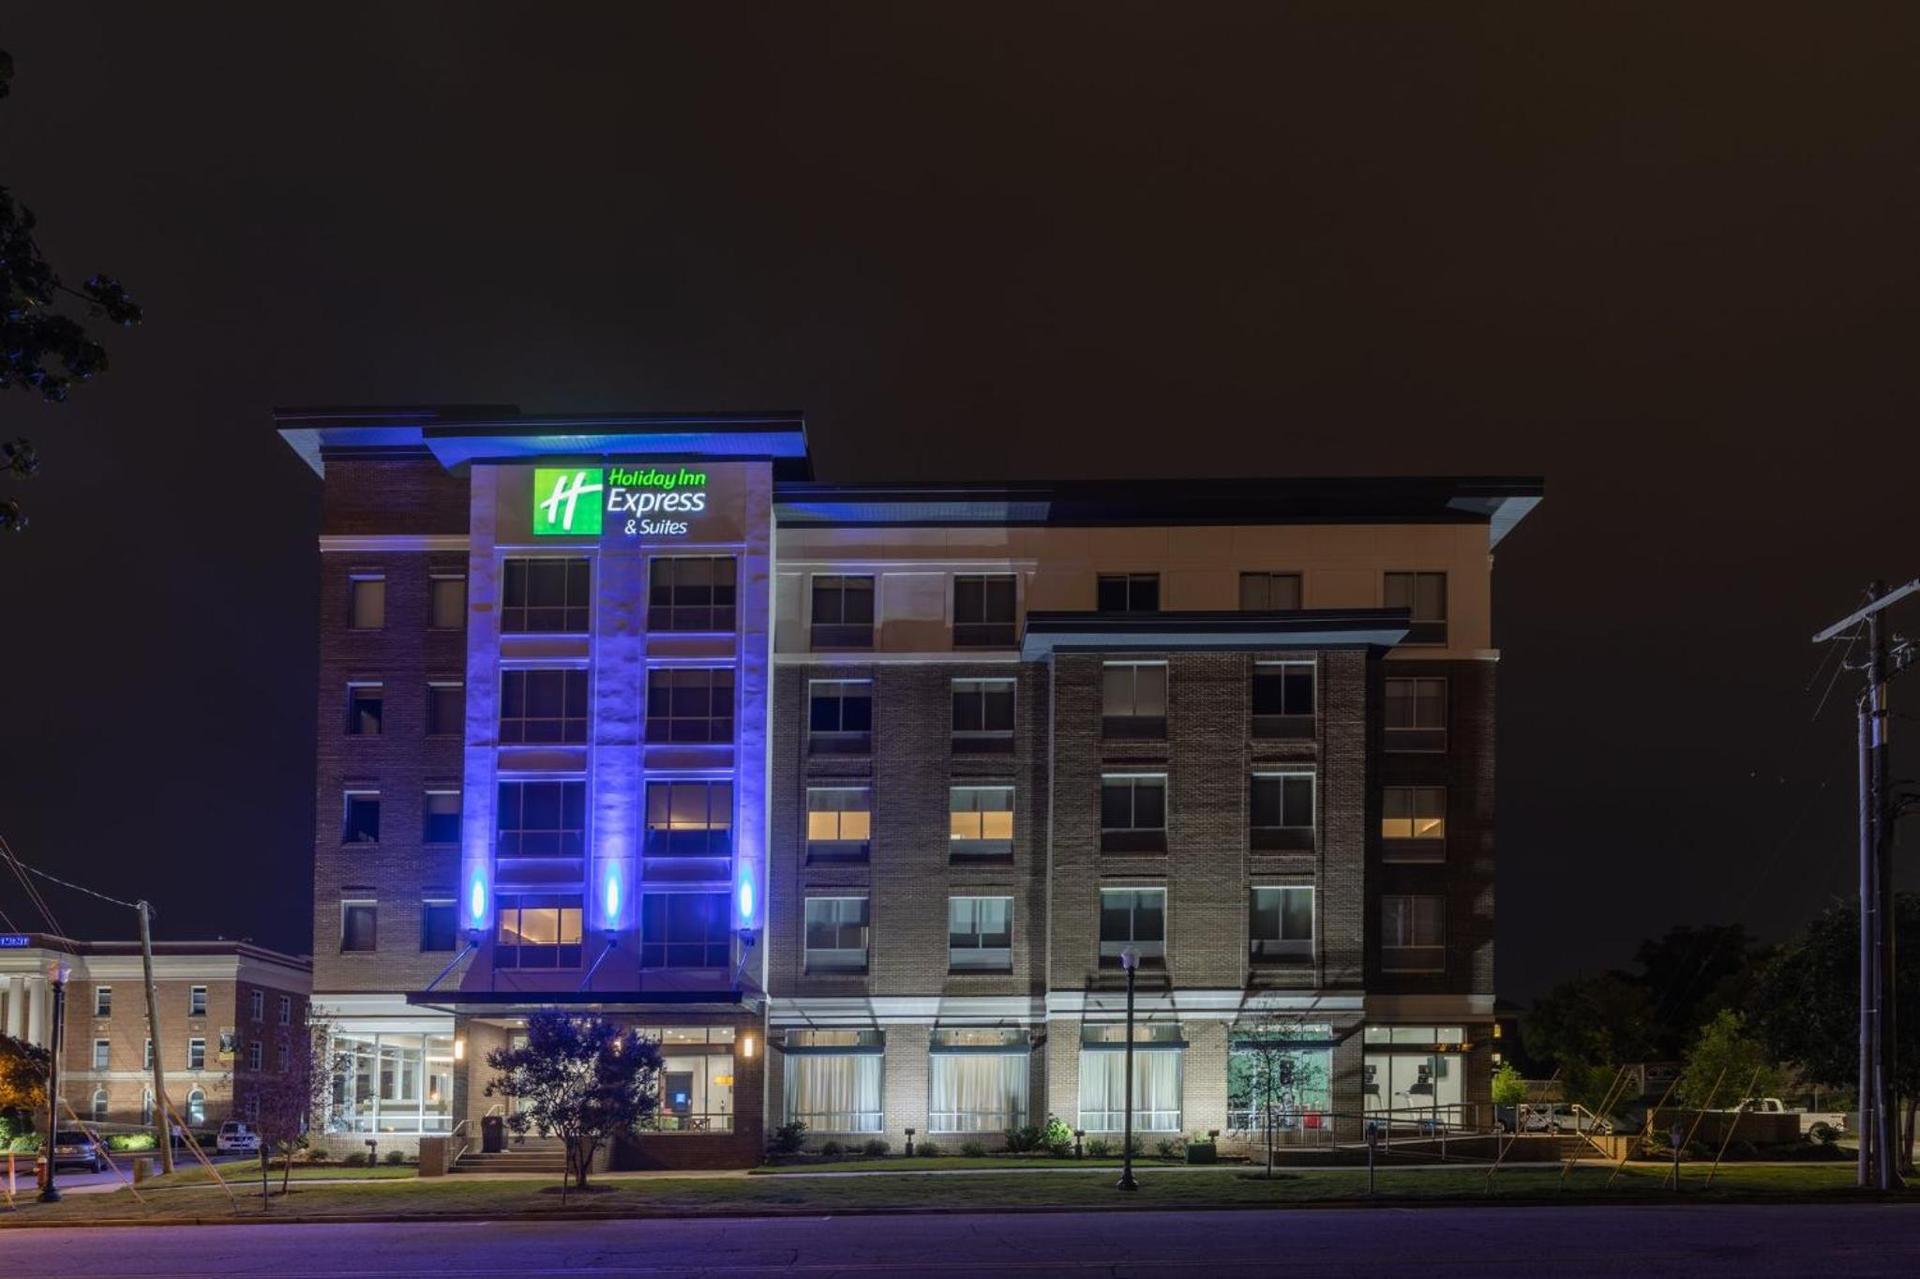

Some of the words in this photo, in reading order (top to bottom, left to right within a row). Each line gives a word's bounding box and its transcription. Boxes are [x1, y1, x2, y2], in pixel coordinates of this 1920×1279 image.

[608, 468, 676, 488] Holiday
[678, 468, 706, 485] Inn
[540, 472, 603, 530] H
[607, 488, 706, 518] Express
[624, 519, 637, 534] &
[639, 519, 688, 535] Suites
